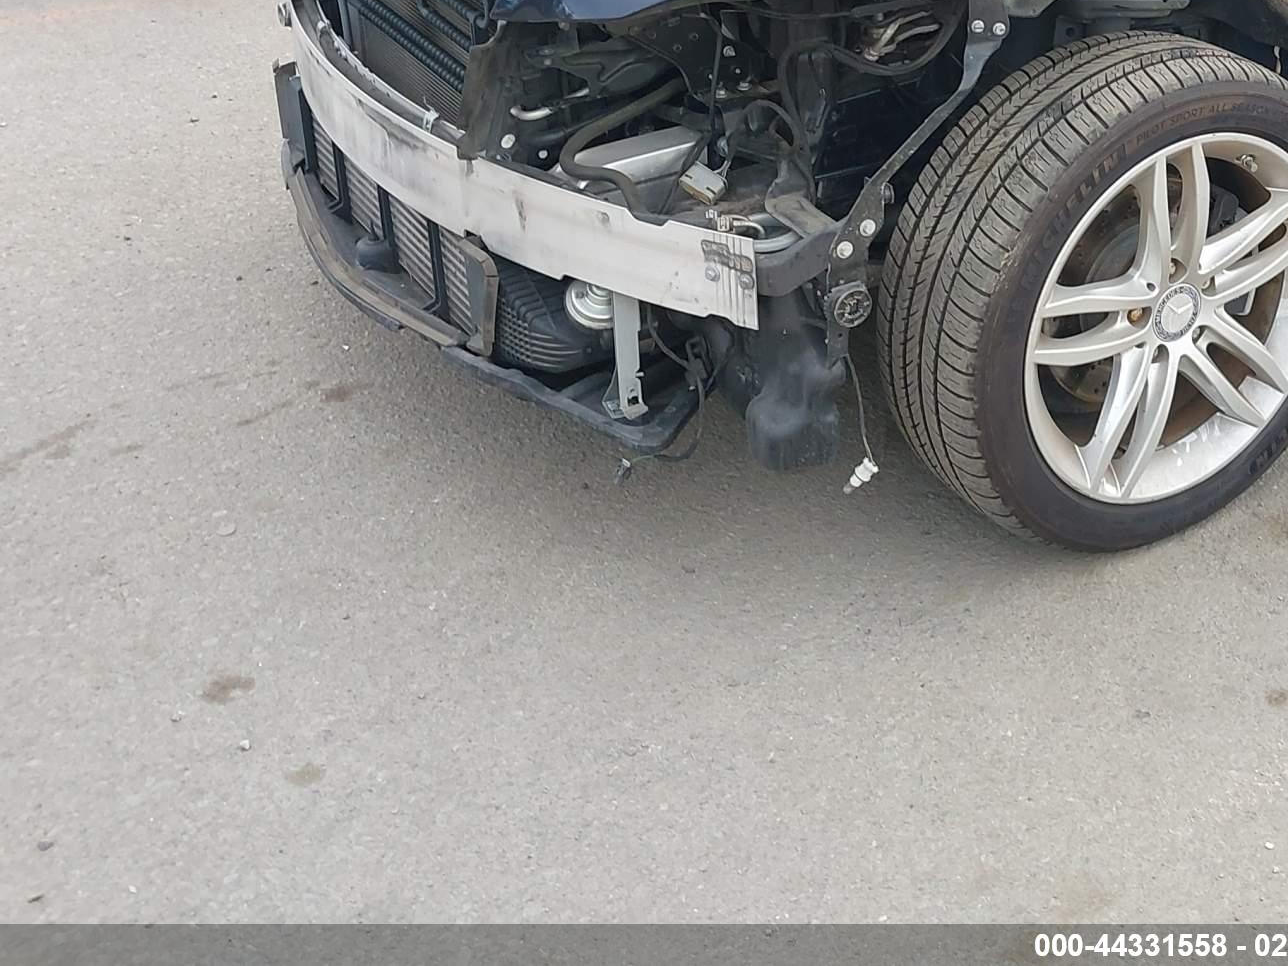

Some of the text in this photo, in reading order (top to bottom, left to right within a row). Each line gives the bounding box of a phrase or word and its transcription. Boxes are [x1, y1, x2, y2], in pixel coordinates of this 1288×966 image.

[1135, 119, 1167, 146] PILOT
[1168, 107, 1205, 127] SPORT
[1208, 104, 1228, 116] ALL
